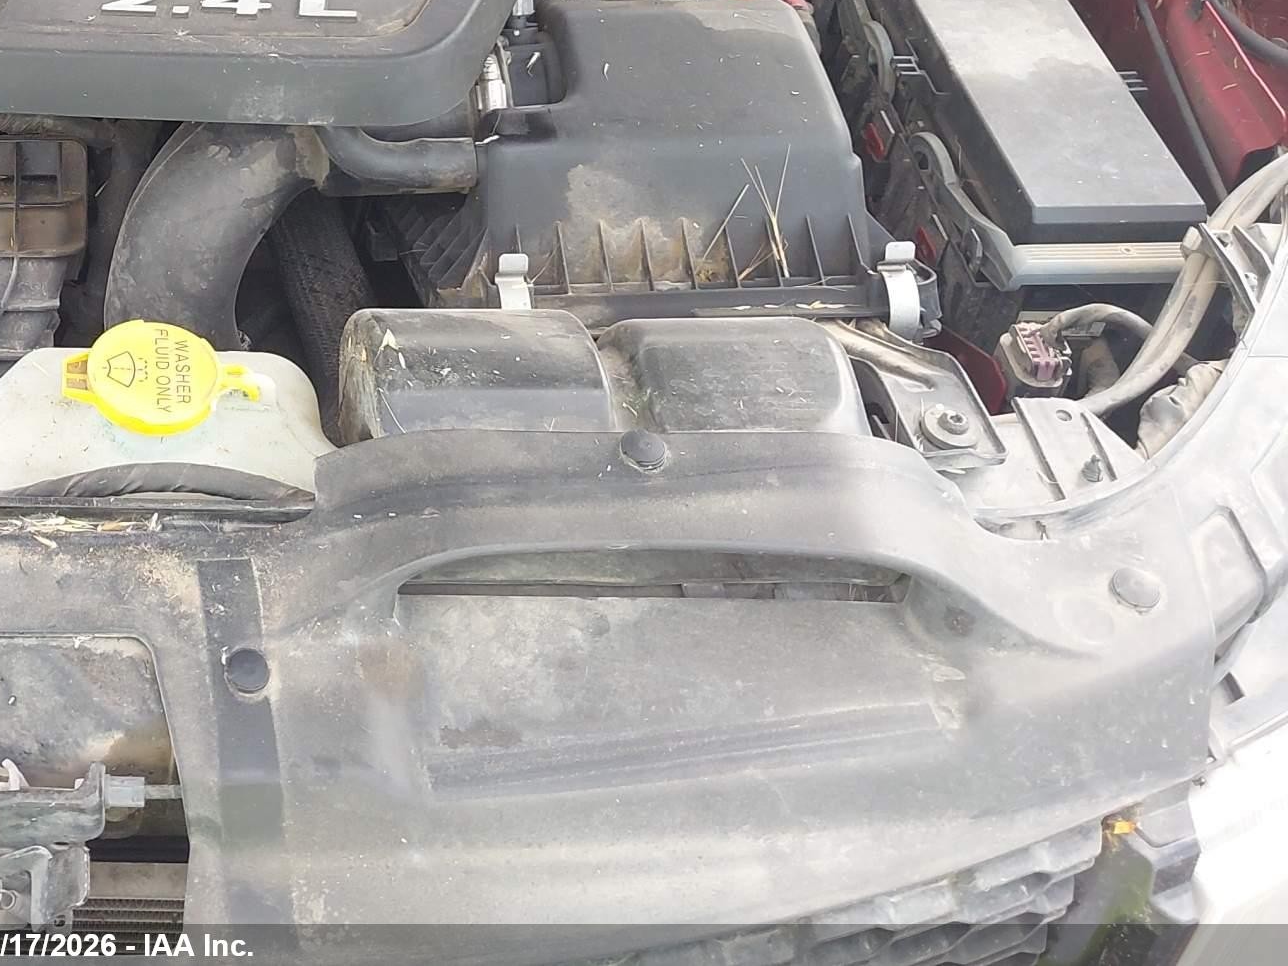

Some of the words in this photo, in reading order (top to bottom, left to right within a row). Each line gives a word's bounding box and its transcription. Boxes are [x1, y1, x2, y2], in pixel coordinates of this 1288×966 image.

[154, 329, 170, 370] FLUID
[174, 339, 192, 405] WASHER
[155, 375, 173, 414] ONLY
